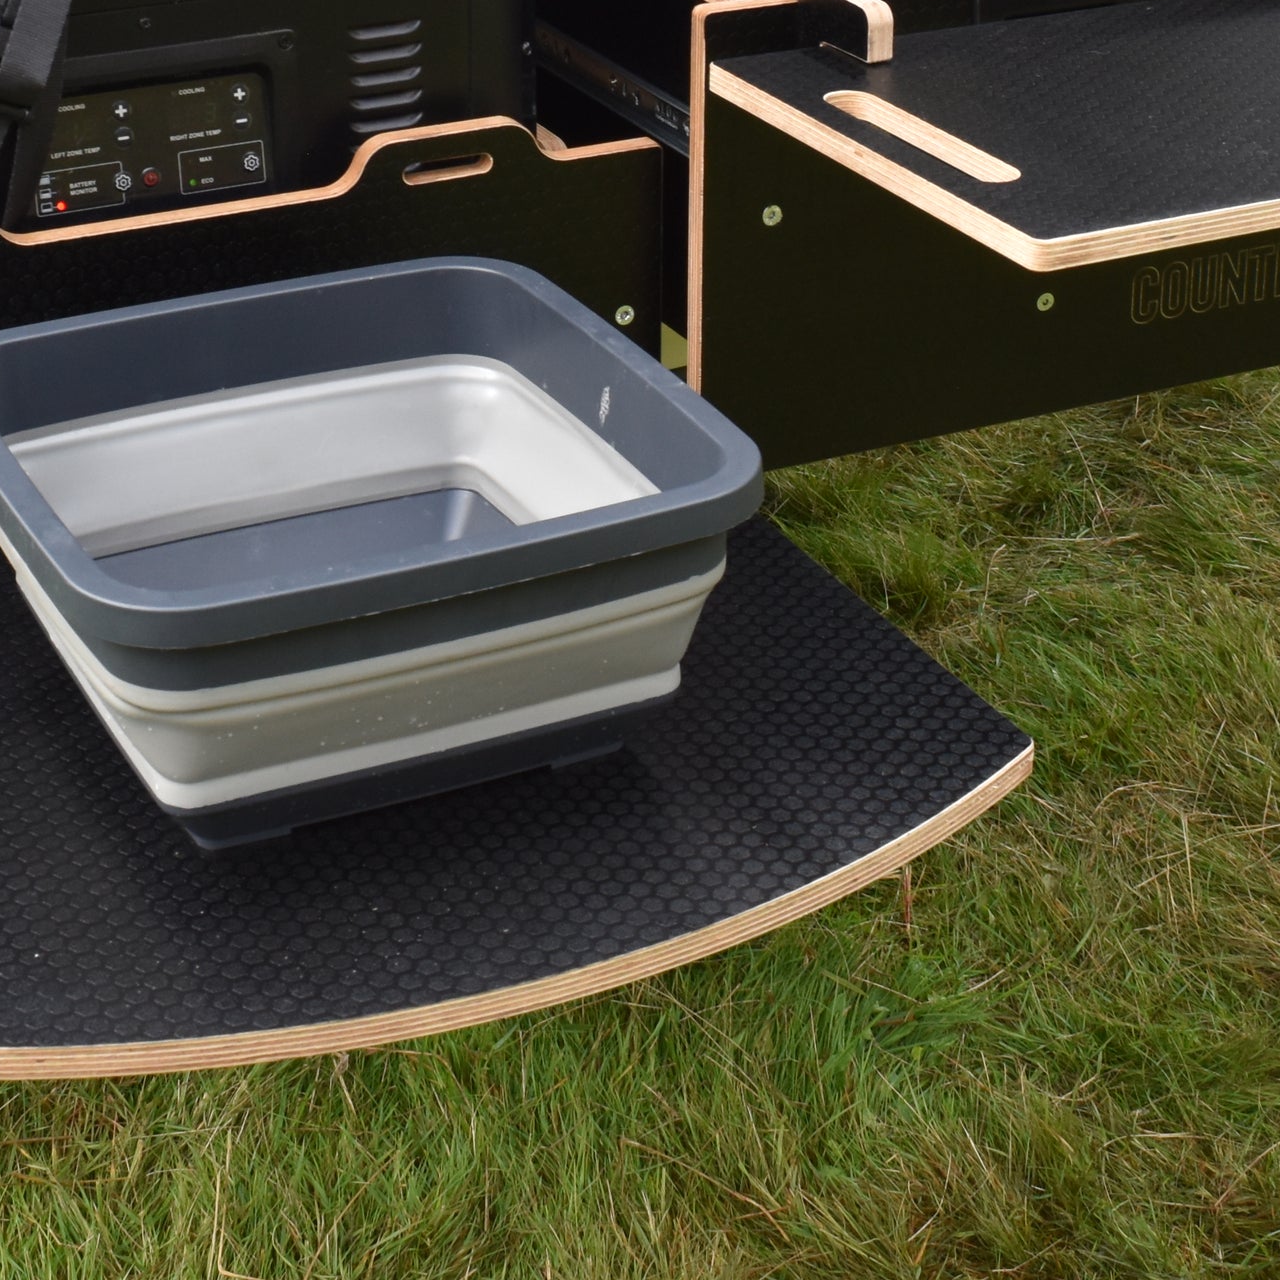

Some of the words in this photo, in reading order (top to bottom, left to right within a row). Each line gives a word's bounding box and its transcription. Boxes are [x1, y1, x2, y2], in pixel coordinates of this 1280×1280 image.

[178, 86, 206, 96] COOLING
[57, 103, 86, 113] COOLING
[169, 133, 188, 142] RIGHT
[188, 131, 205, 140] ZONE
[205, 128, 222, 137] TEMP
[50, 151, 66, 160] LEFT
[66, 148, 83, 157] ZONE
[83, 146, 101, 155] TEMP
[199, 155, 213, 163] MAX
[69, 179, 97, 189] BATTERY
[200, 177, 215, 185] ECO
[69, 186, 98, 197] MONITOR
